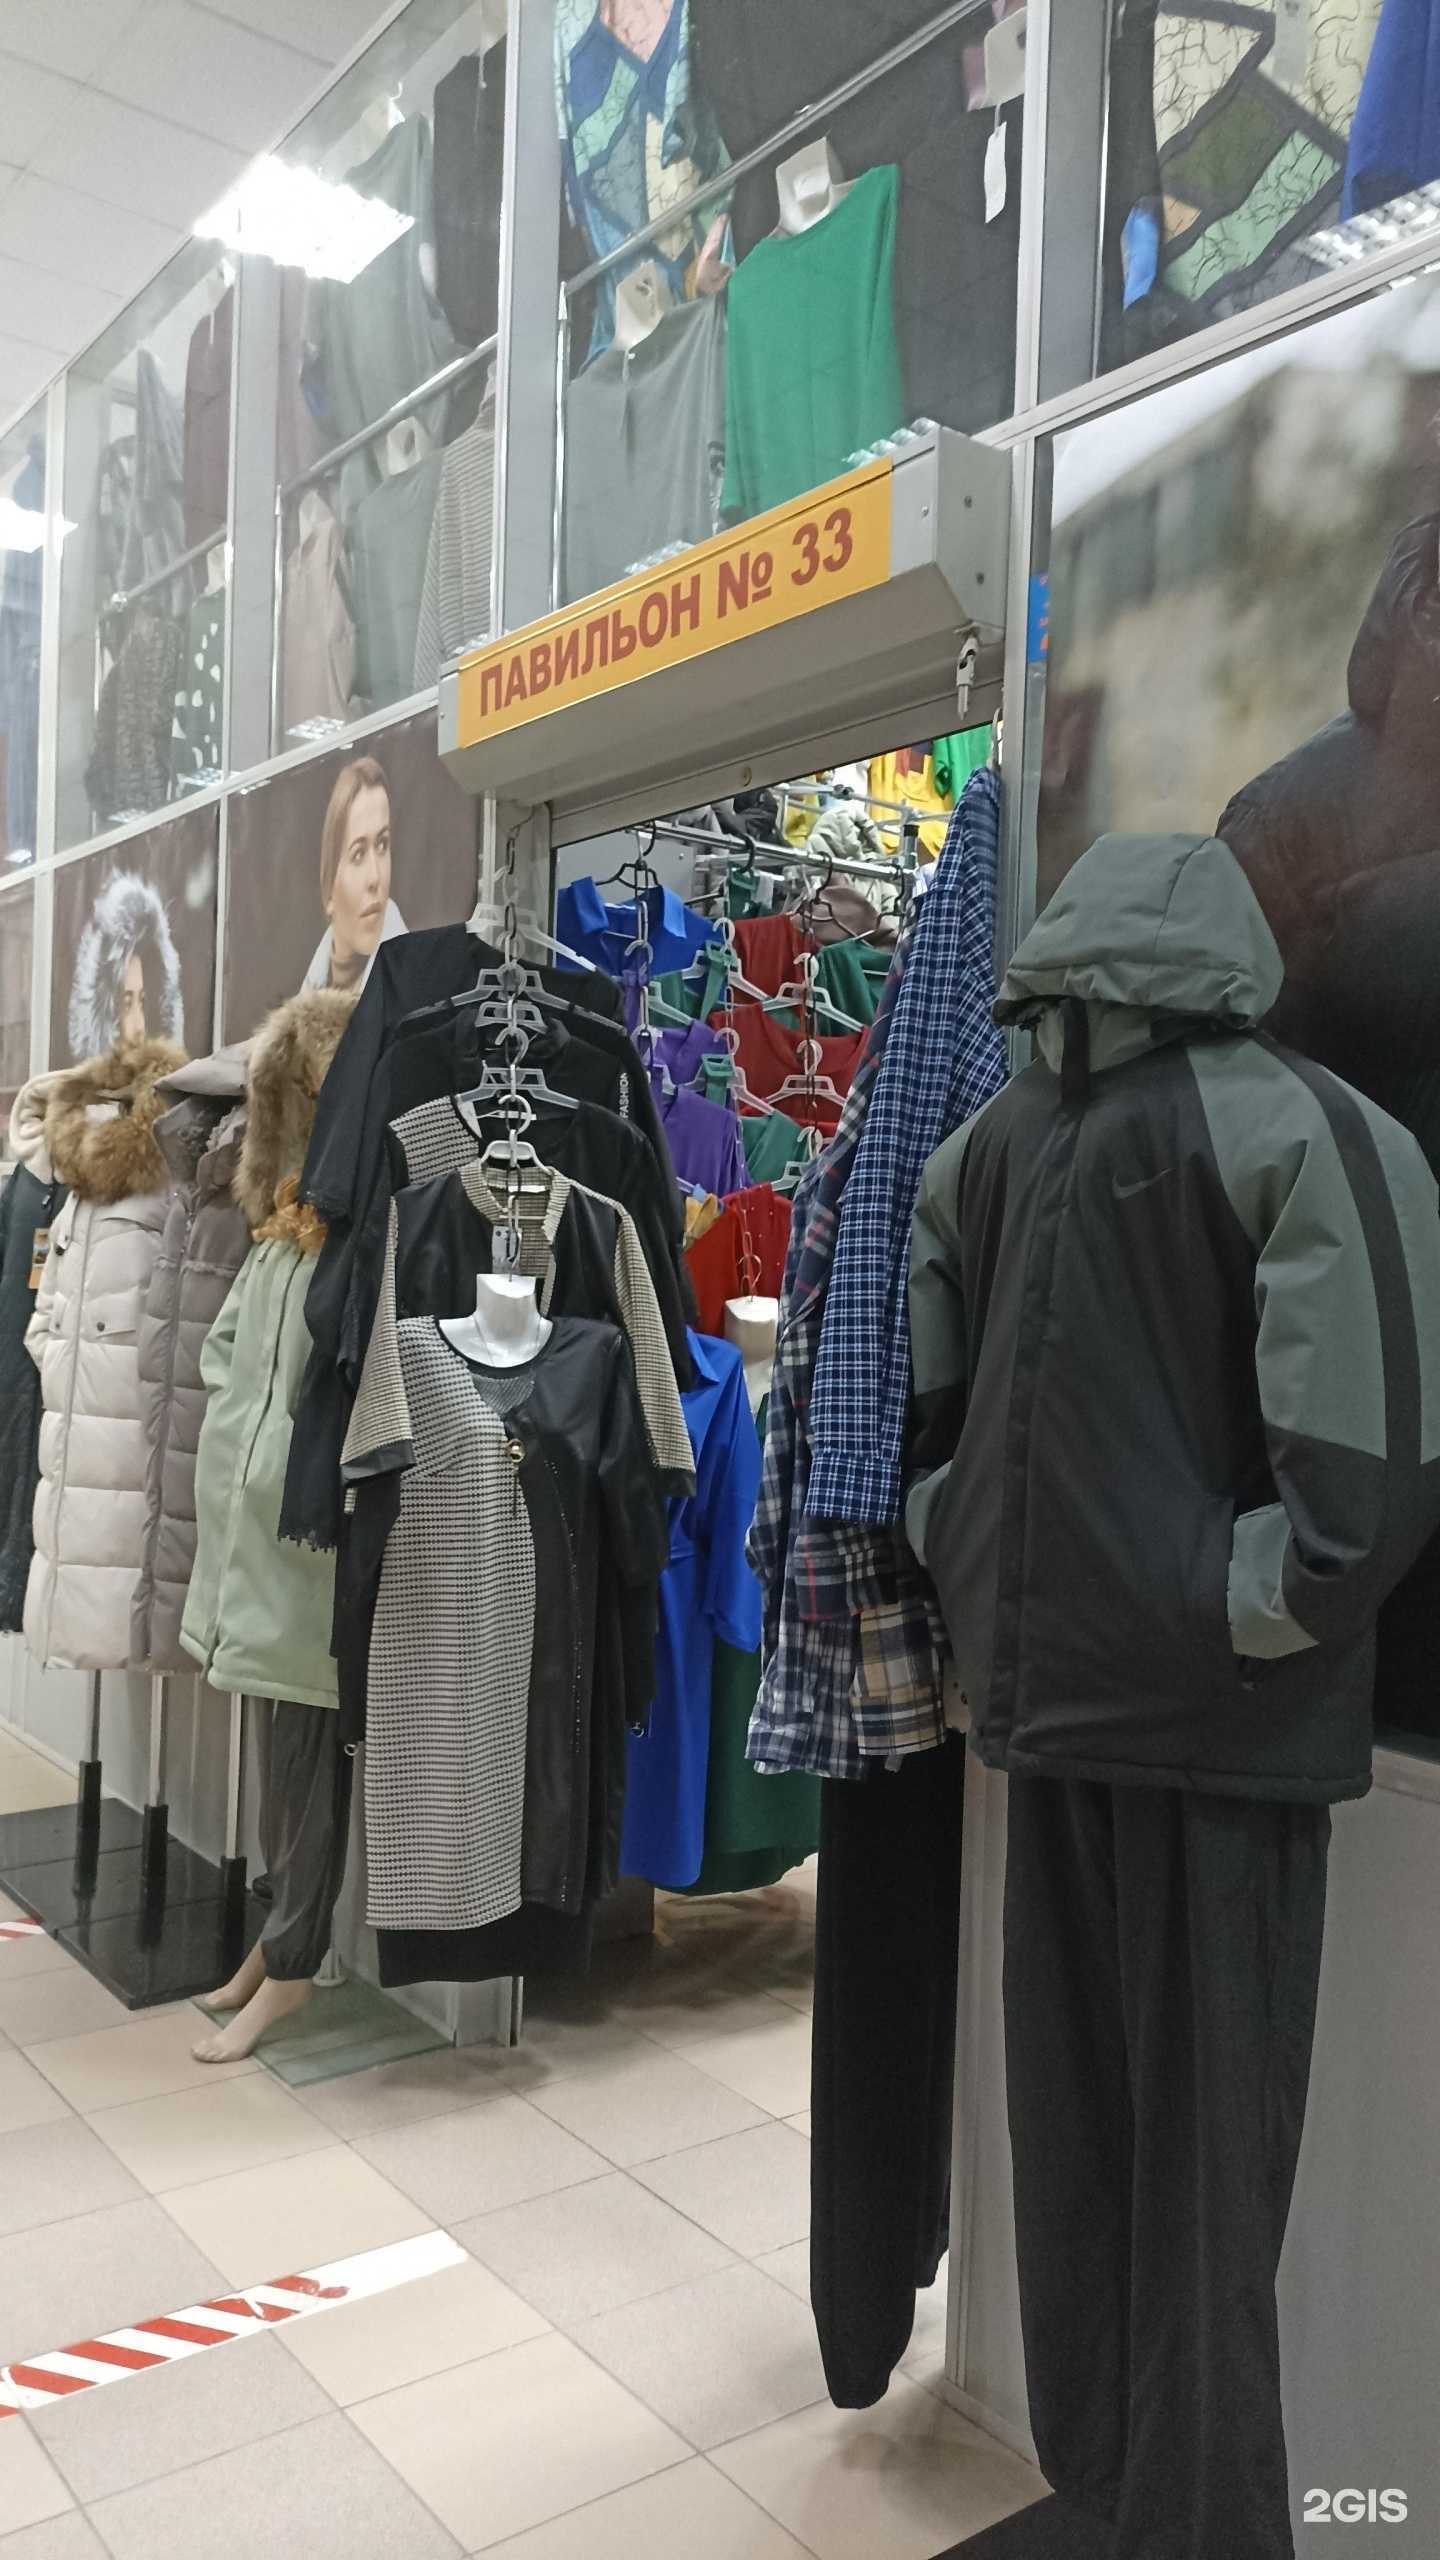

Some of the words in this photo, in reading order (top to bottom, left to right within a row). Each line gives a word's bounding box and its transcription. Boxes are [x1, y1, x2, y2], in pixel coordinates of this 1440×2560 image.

[480, 573, 702, 718] ПАВИЛЬОН
[717, 550, 774, 620] №
[790, 506, 854, 587] 33
